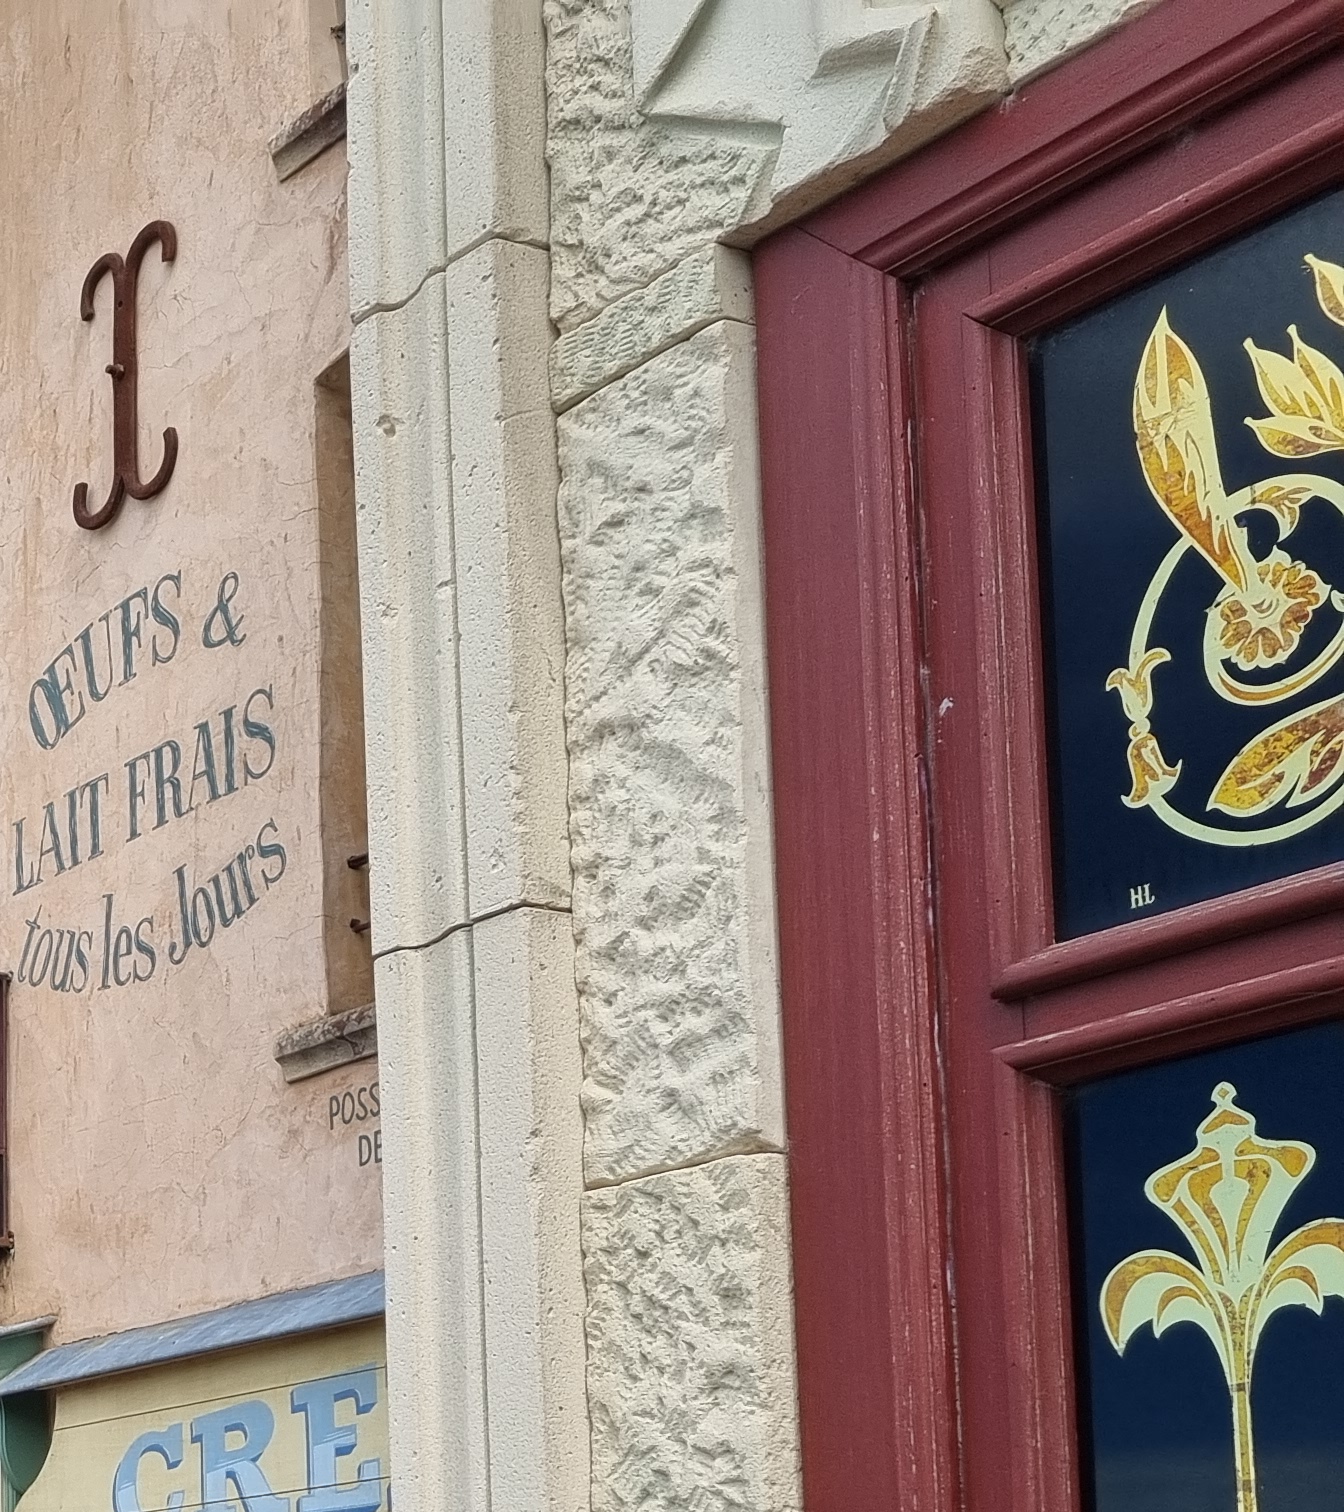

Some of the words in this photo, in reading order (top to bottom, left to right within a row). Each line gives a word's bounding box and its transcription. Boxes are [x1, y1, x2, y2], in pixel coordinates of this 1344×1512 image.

[28, 570, 182, 750] ŒUFS
[202, 571, 247, 649] &
[12, 773, 109, 896] LAIT
[123, 683, 276, 843] FRAIS
[17, 904, 94, 993] tous
[97, 893, 158, 991] les
